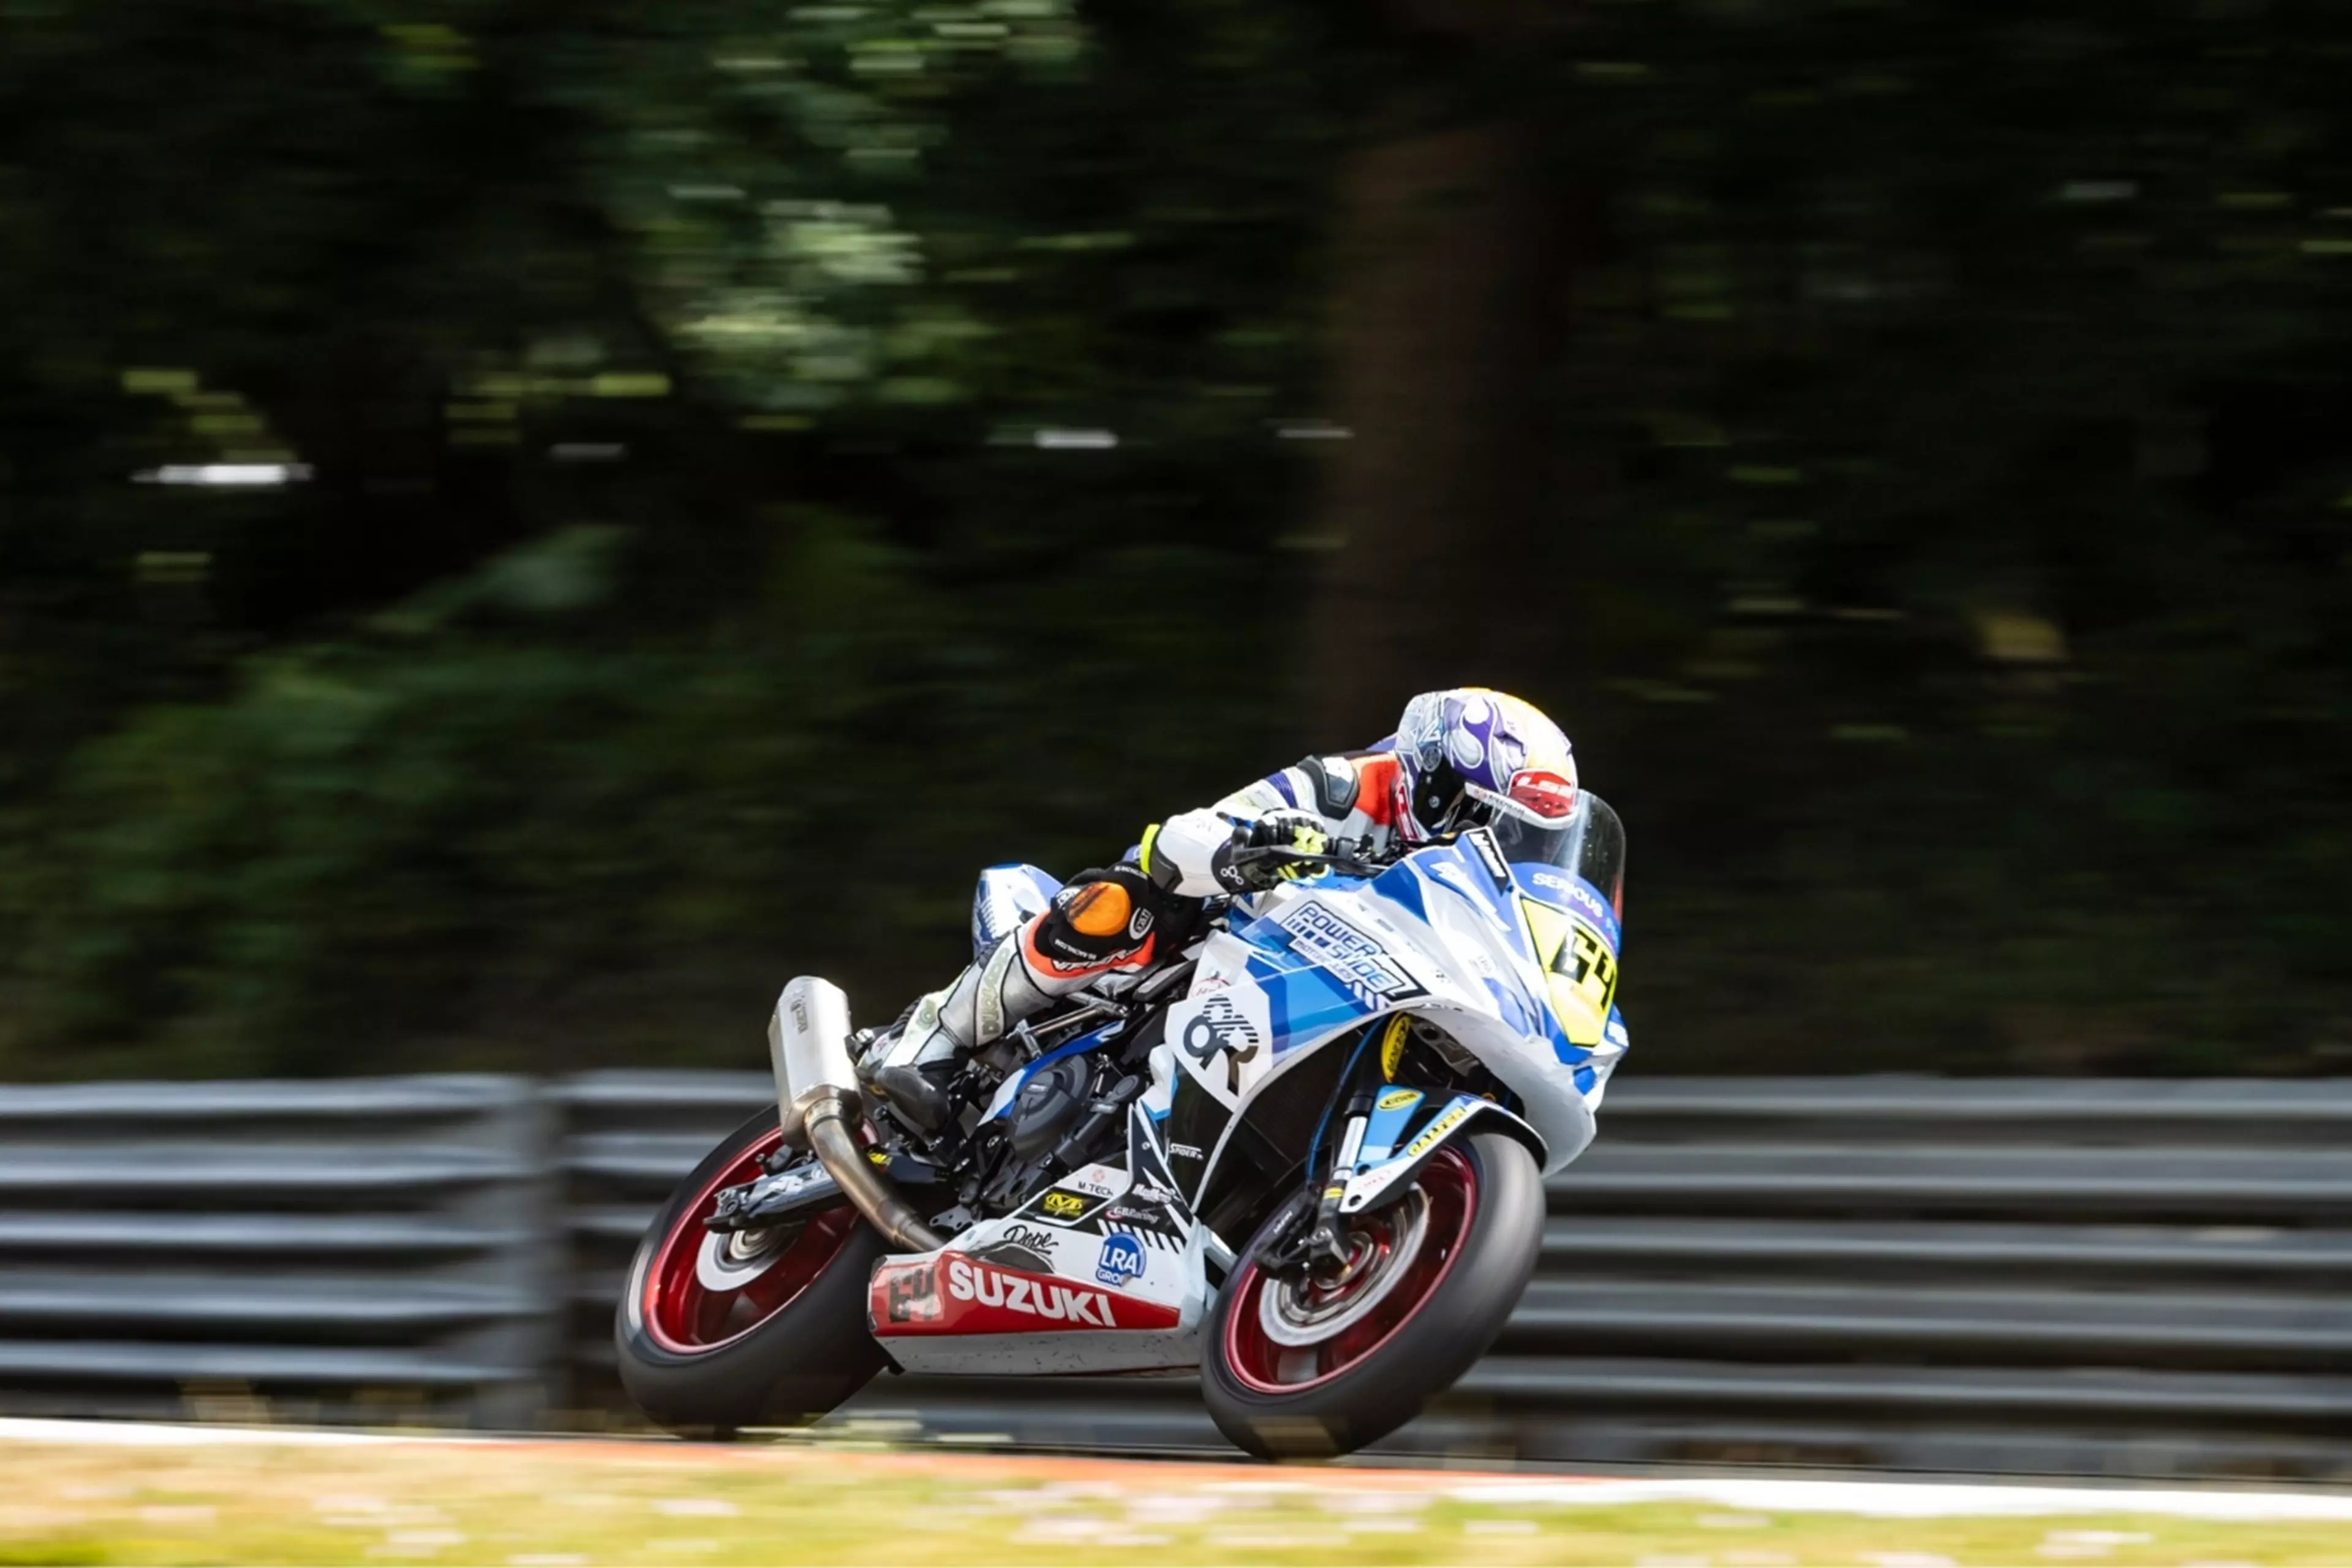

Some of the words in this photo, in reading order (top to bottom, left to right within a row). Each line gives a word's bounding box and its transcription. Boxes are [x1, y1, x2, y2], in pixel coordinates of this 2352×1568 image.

[1298, 907, 1377, 957] POWER
[1550, 925, 1616, 1011] 64
[1003, 1225, 1058, 1251] Dope
[1100, 1245, 1137, 1274] LRA
[949, 1261, 1117, 1327] SUZUKI
